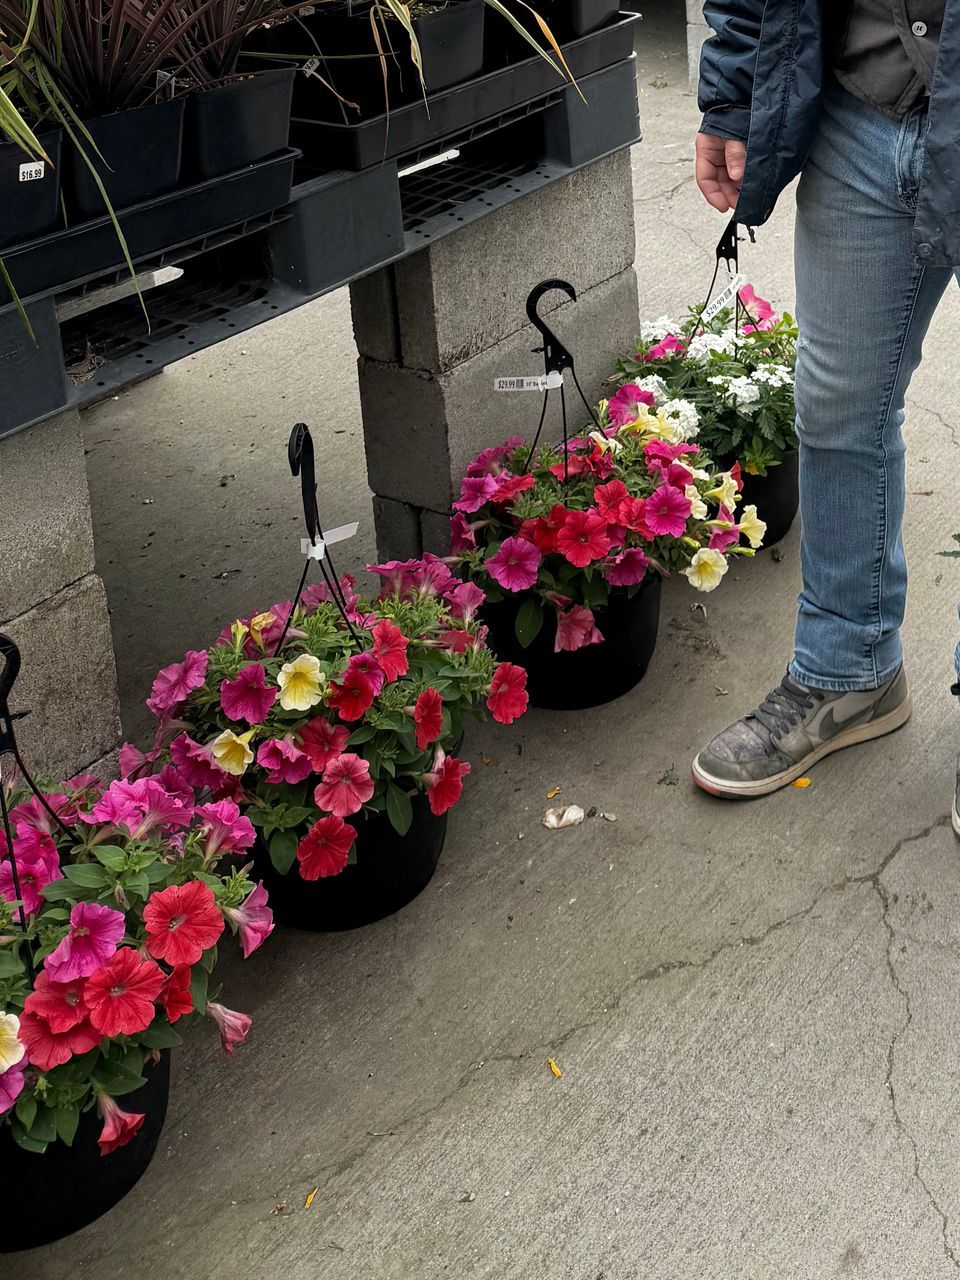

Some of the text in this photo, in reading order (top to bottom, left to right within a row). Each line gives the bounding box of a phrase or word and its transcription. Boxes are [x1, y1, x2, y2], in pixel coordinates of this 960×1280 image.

[21, 169, 42, 180] $16.99
[705, 296, 725, 318] $29.99
[498, 380, 516, 389] $29.99
